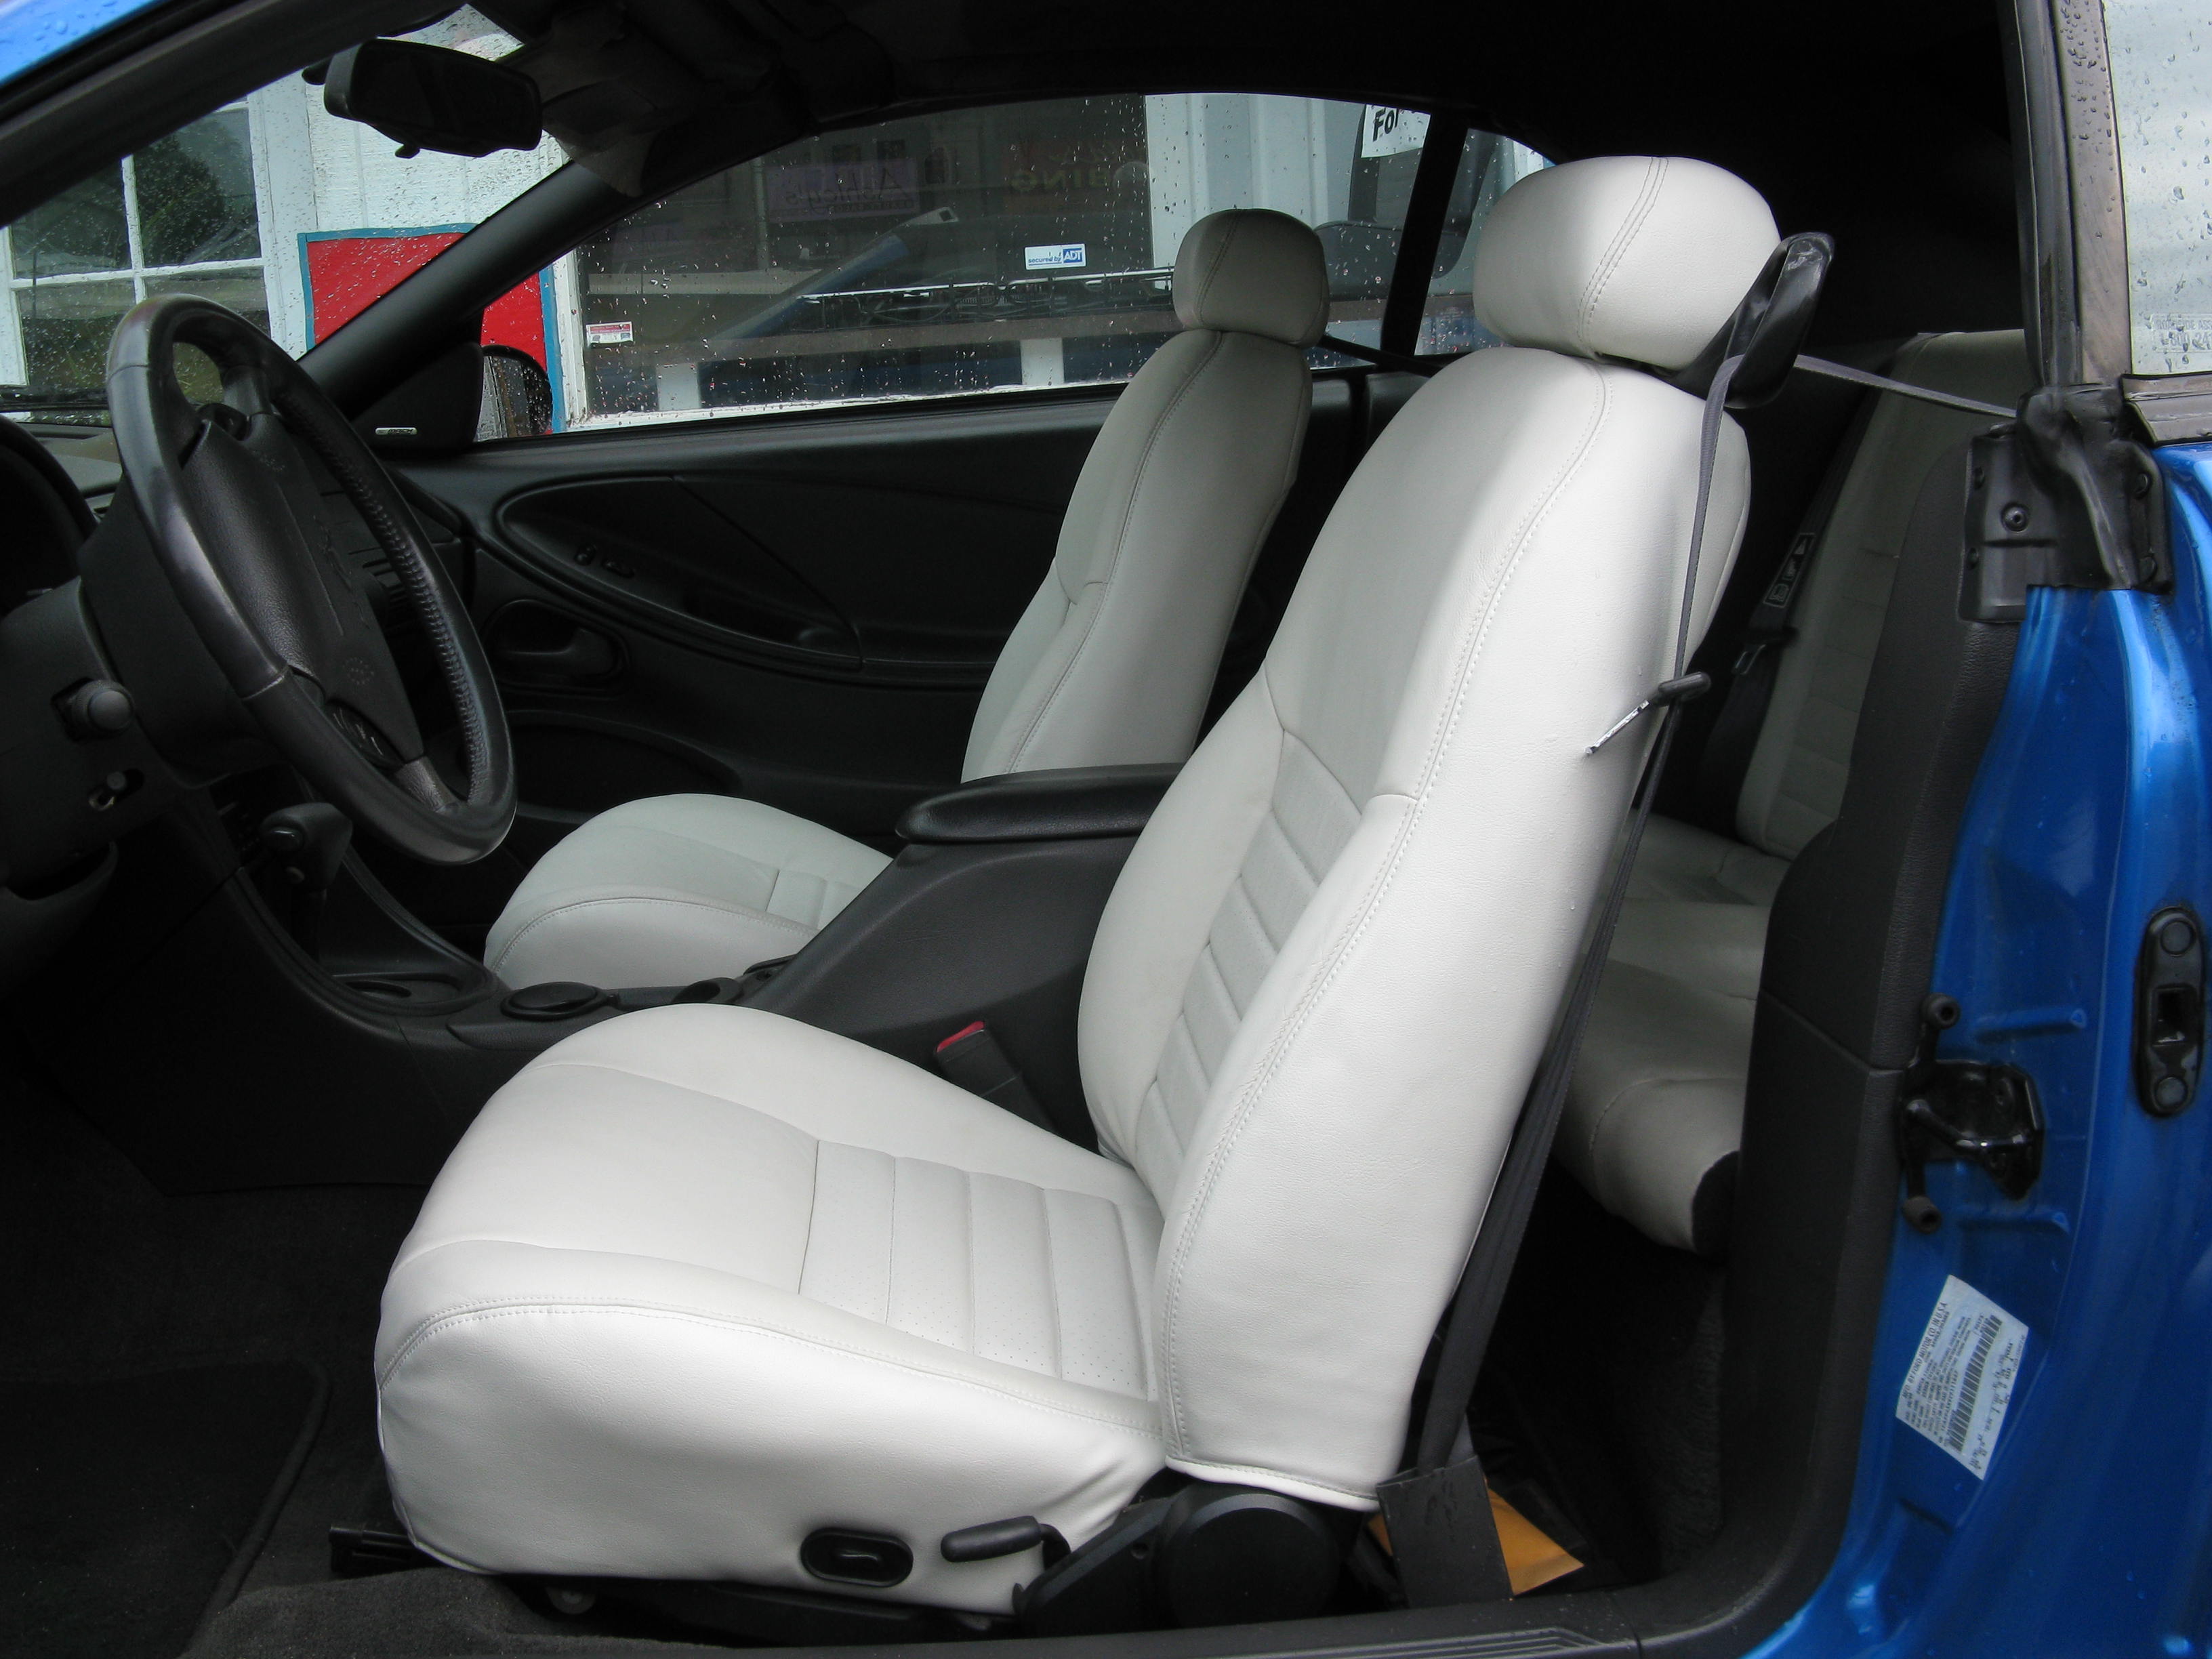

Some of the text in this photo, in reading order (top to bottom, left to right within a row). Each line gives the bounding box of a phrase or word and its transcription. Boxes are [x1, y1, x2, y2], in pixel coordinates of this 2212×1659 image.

[1063, 249, 1082, 262] ADT
[1911, 1358, 1923, 1375] FORD
[1919, 1336, 1932, 1357] MOTOR
